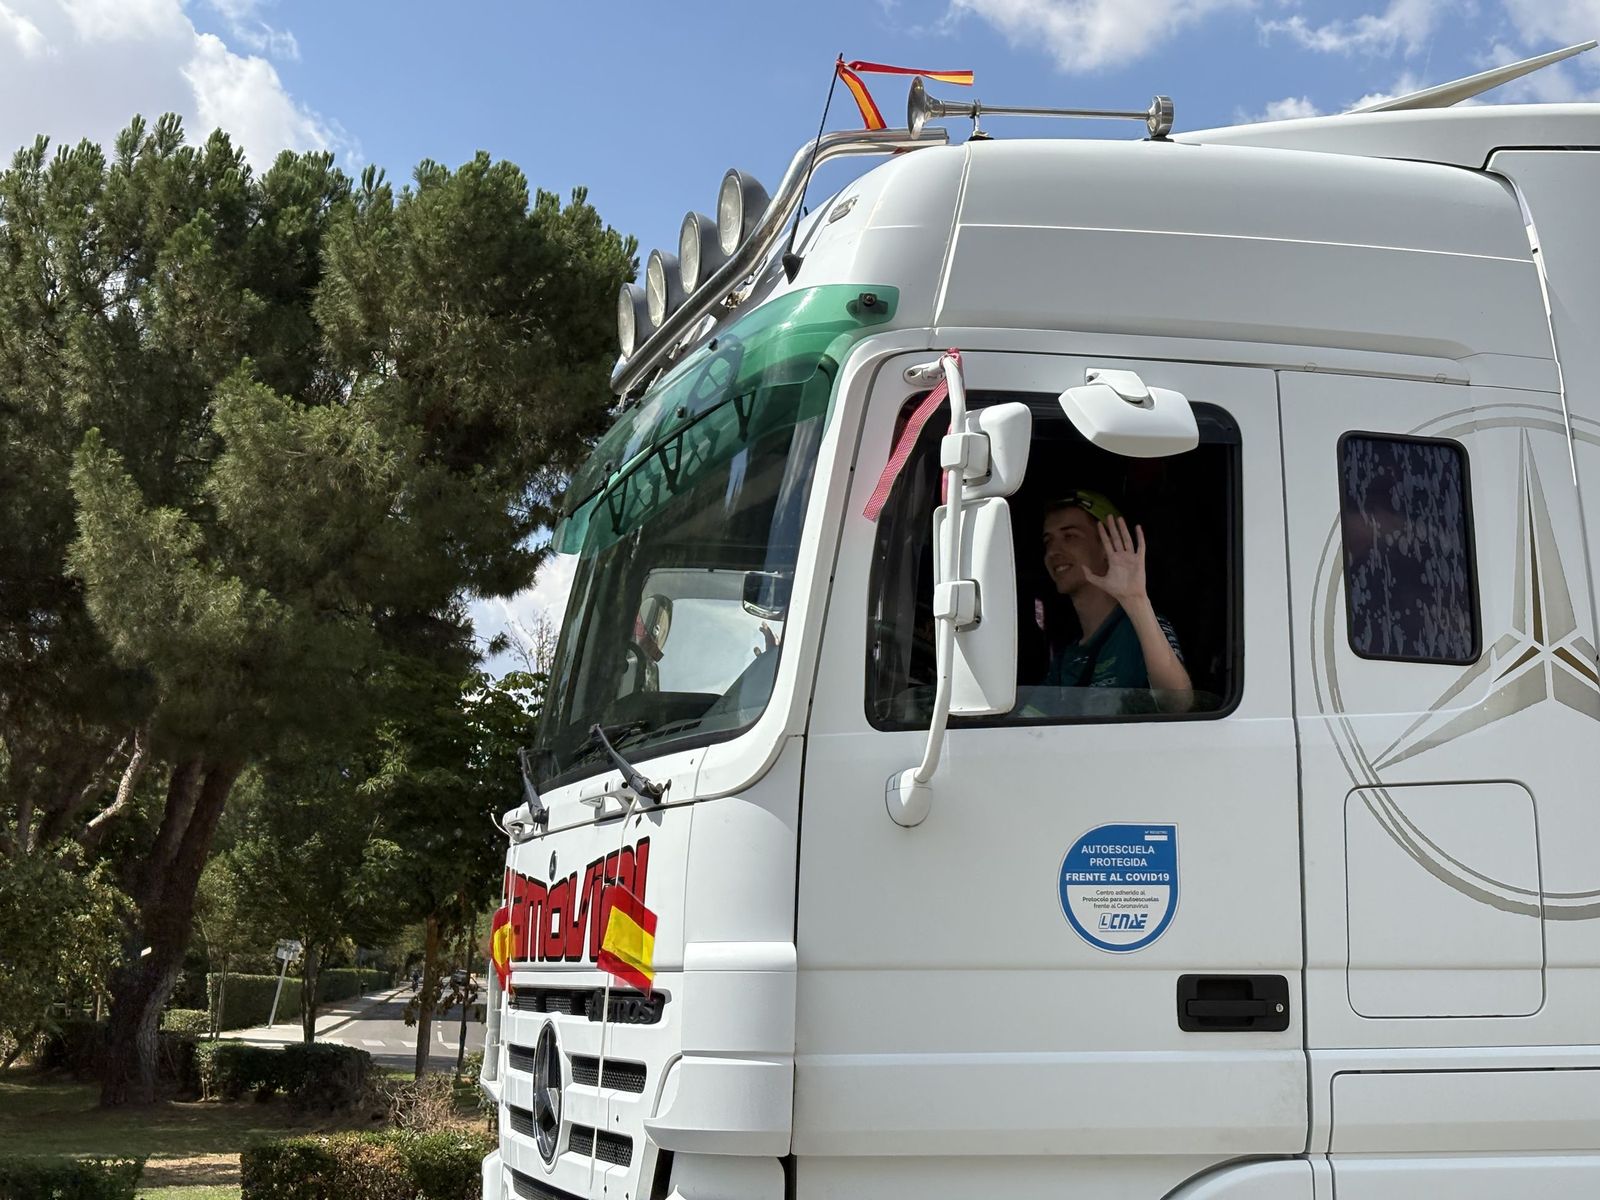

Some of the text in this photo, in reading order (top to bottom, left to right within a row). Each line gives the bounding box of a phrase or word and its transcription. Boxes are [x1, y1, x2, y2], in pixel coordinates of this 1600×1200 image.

[1081, 845, 1155, 854] AUTOESCUELA
[1089, 858, 1148, 867] PROTEGIDA
[1065, 873, 1170, 881] FRENTE AL COVID19
